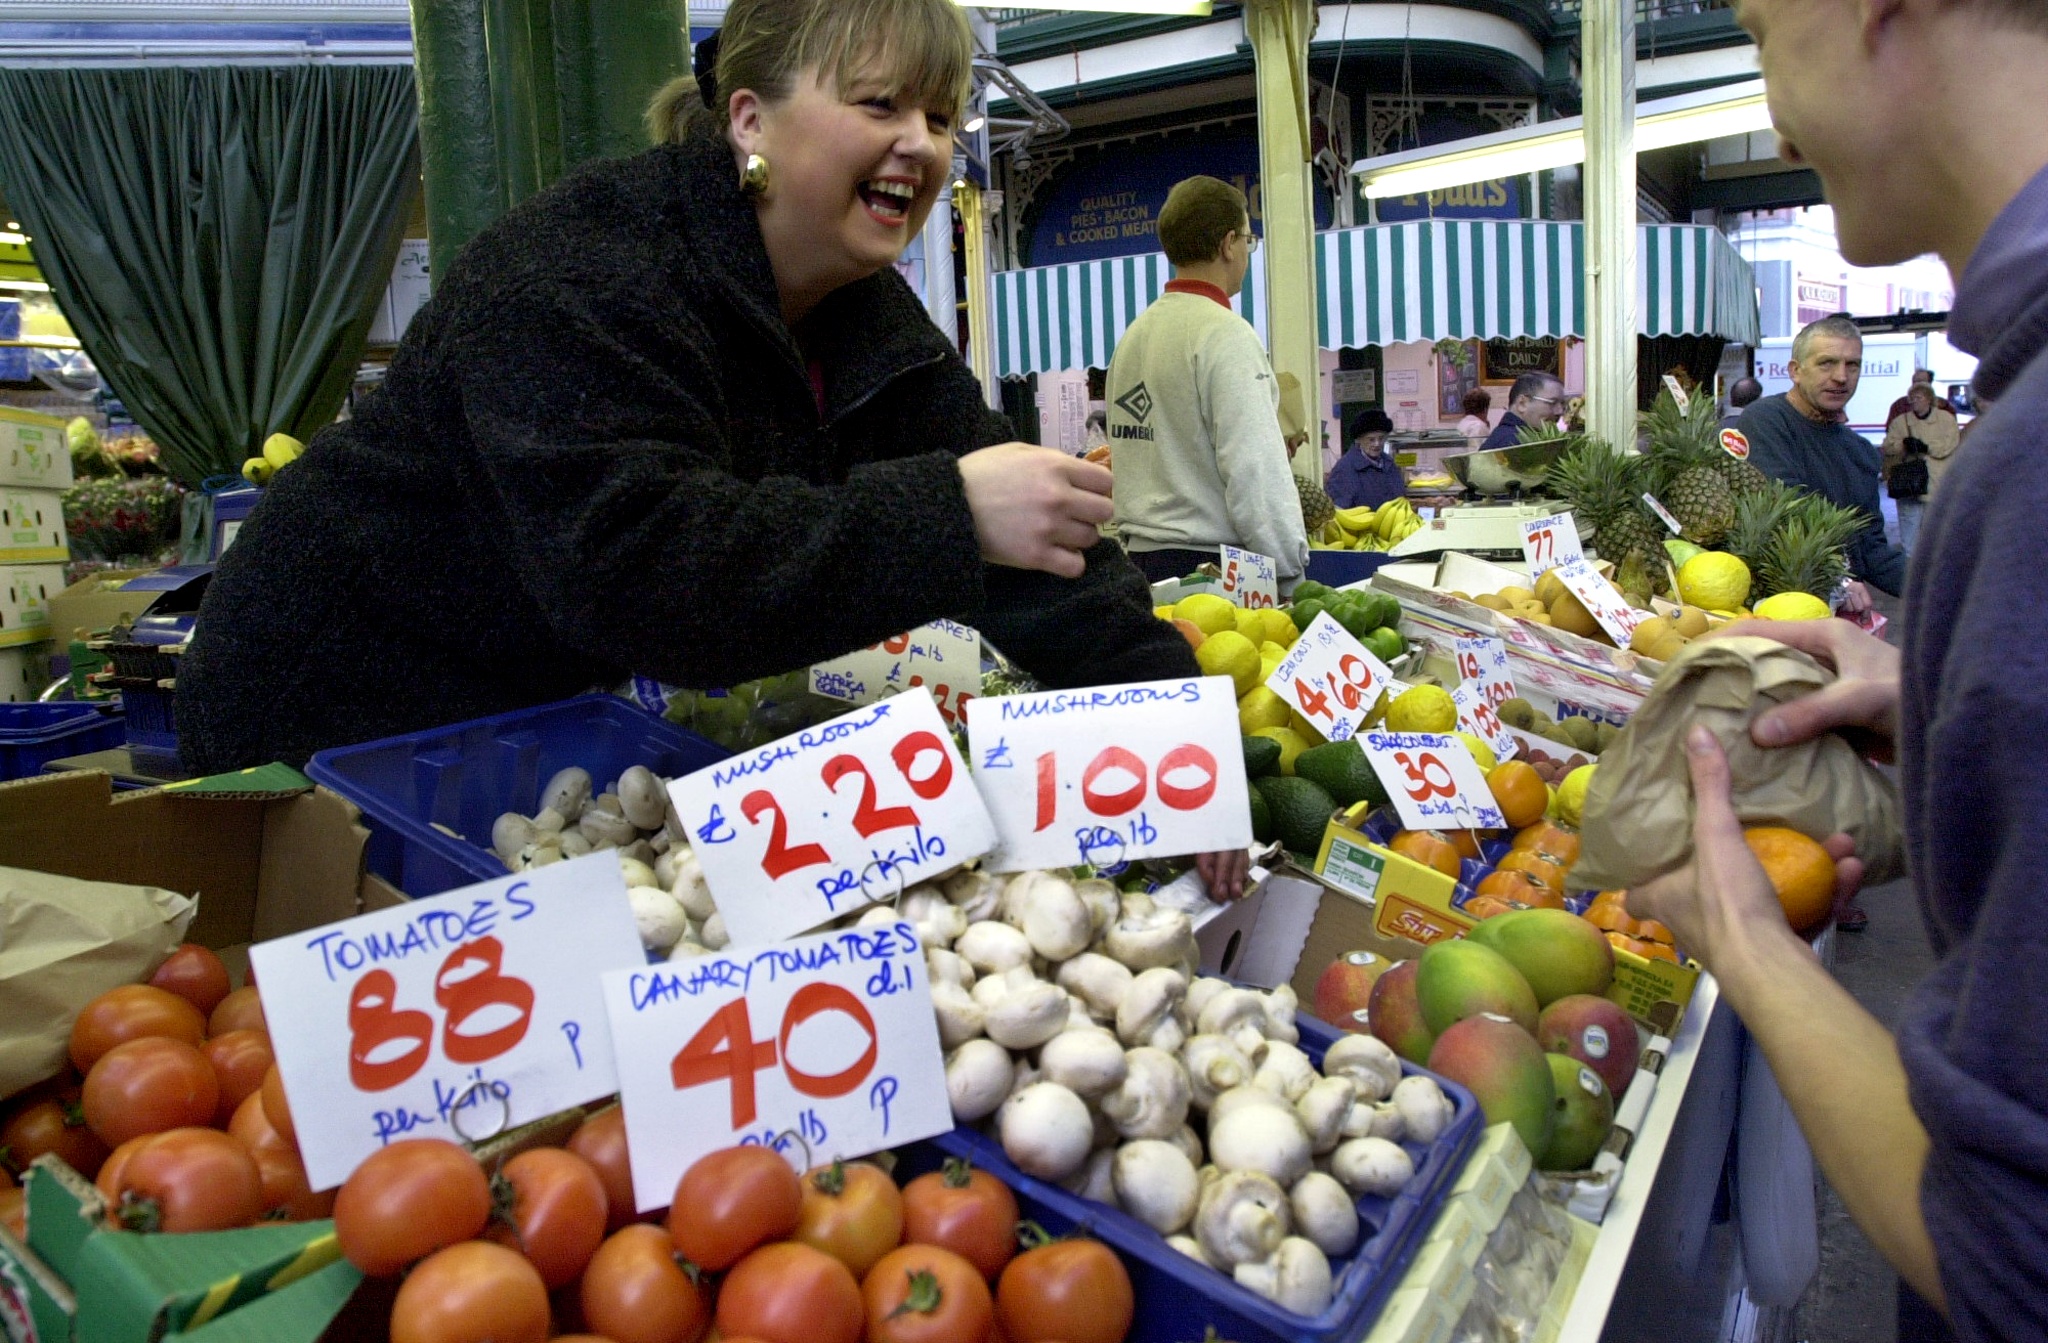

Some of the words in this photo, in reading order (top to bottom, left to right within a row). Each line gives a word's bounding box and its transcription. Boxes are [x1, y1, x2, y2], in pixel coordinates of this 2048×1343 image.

[1081, 191, 1137, 212] QUALITY
[1055, 232, 1065, 247] &
[1069, 225, 1119, 243] COOKED
[1508, 352, 1541, 366] DAILY
[1527, 529, 1553, 563] 77
[1223, 561, 1238, 592] 5
[1276, 638, 1312, 683] LEMONS
[1458, 652, 1478, 679] 10
[1001, 682, 1203, 721] MUSHROOMS
[1294, 676, 1334, 722] 4
[1325, 653, 1372, 711] 60
[1393, 751, 1457, 803] 30
[1129, 810, 1158, 846] lb
[307, 881, 536, 981] TOMATOES
[629, 960, 754, 1012] CANARY
[754, 922, 917, 990] TOMATOES
[347, 934, 535, 1093] 88
[669, 981, 878, 1132] 40
[798, 1108, 828, 1146] lb
